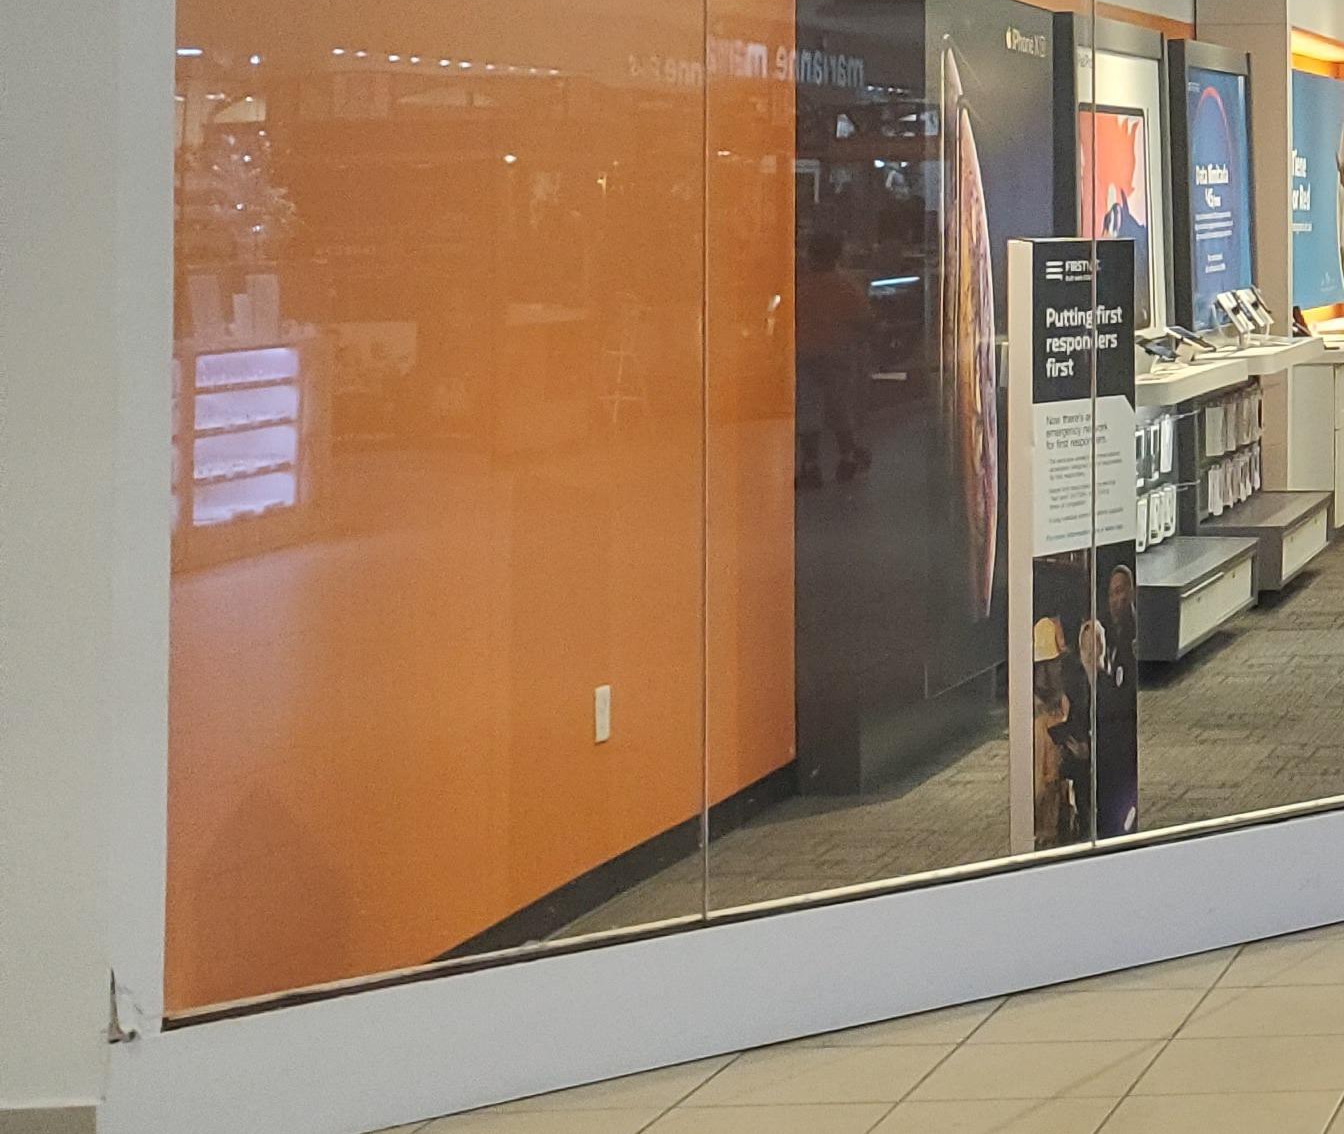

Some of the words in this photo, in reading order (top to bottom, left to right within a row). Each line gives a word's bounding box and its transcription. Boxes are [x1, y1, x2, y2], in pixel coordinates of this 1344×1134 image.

[1046, 307, 1093, 328] Putting
[1096, 304, 1123, 324] first
[1046, 357, 1075, 378] first
